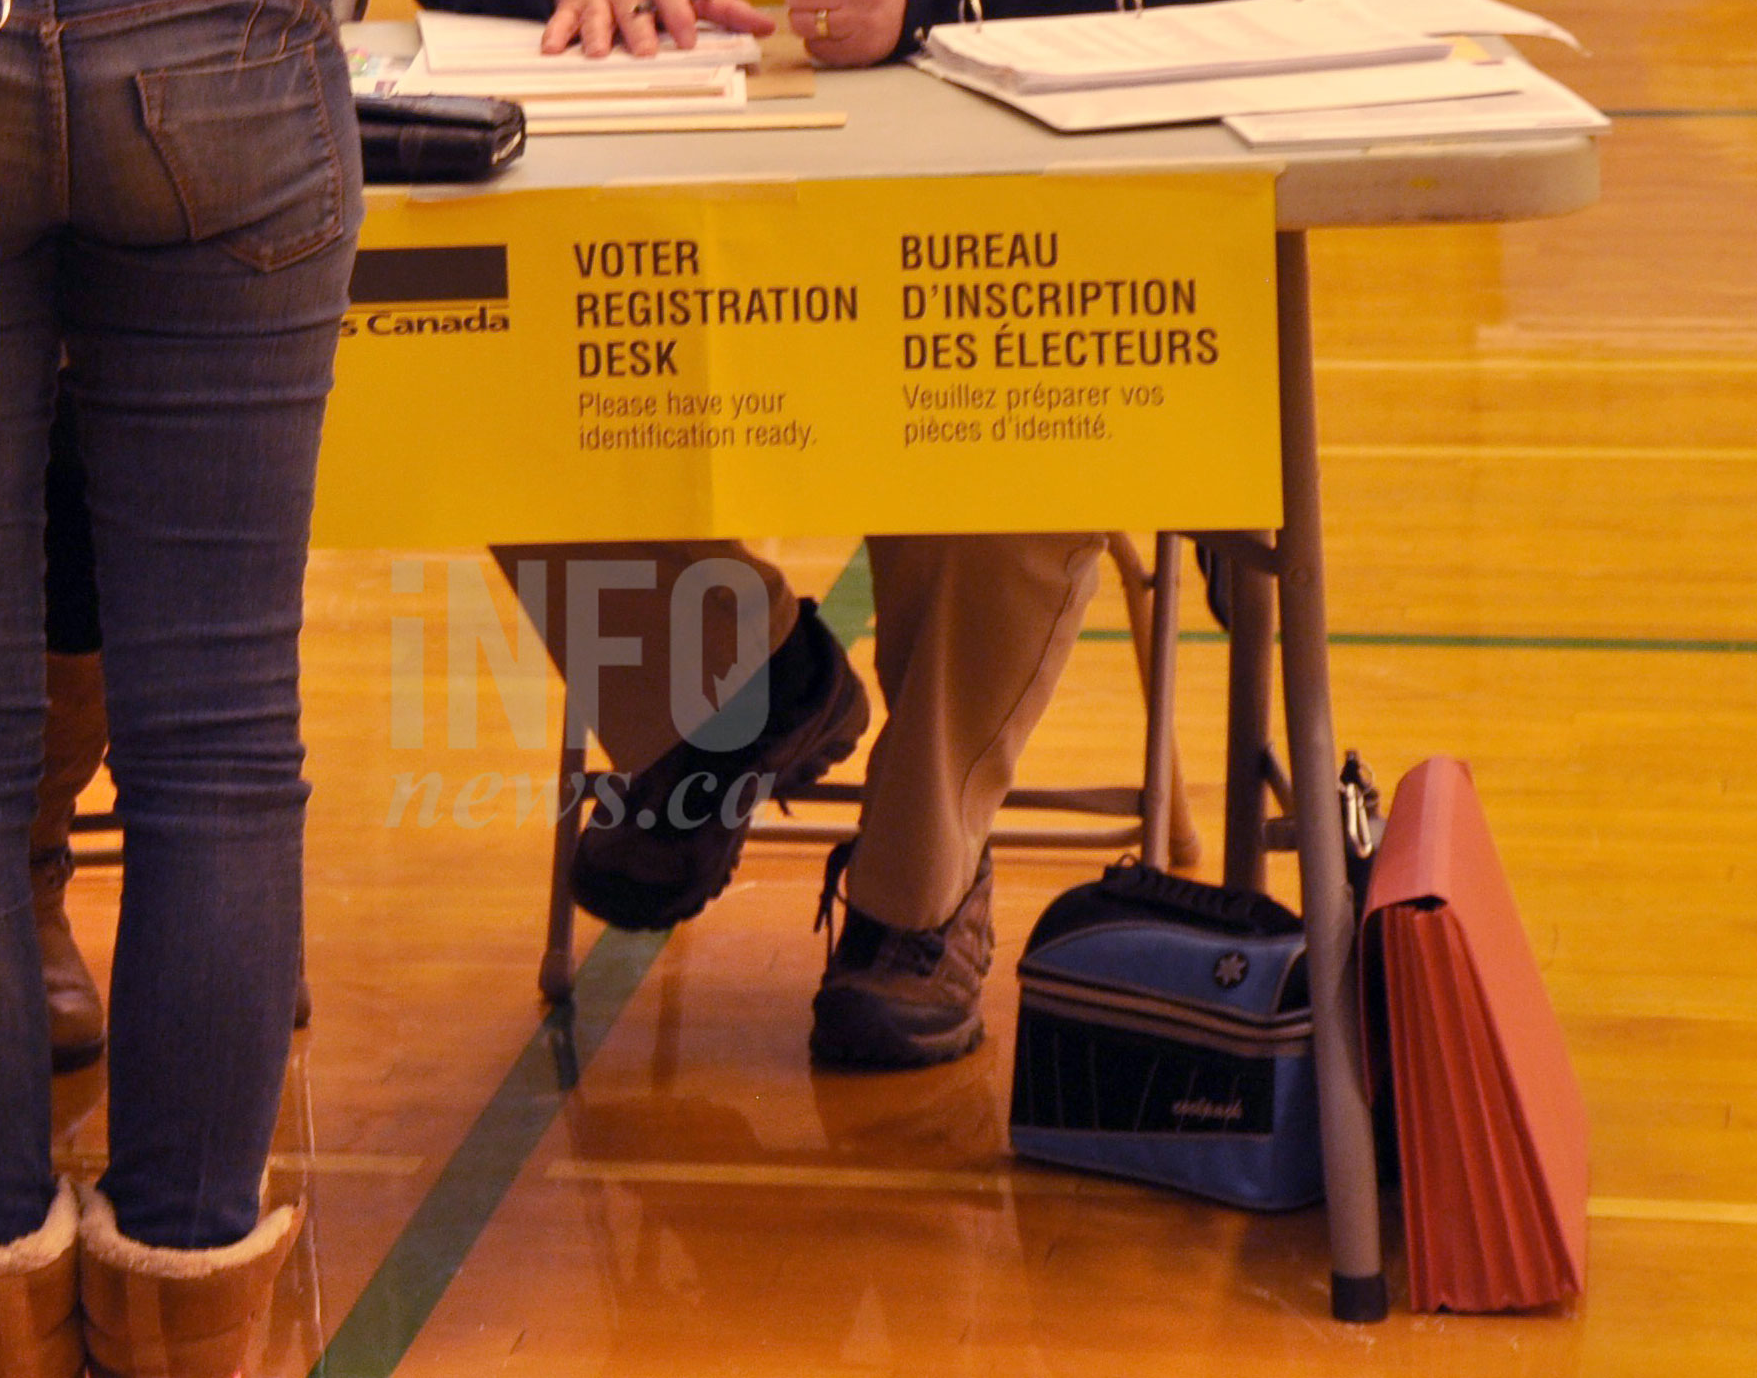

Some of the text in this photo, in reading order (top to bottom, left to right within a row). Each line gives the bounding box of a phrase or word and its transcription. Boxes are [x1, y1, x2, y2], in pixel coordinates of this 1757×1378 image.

[573, 241, 700, 278] VOTER
[901, 232, 1058, 271] BUREAU
[576, 286, 858, 328] REGISTRATION
[902, 279, 1196, 320] D'INSCRIPTION
[366, 306, 510, 336] Canada
[578, 341, 678, 378] DESK
[903, 322, 1219, 370] DES ÉLECTEURS
[579, 390, 786, 421] Please have your
[901, 382, 1165, 413] Veuillez préparer vos
[579, 419, 817, 452] identification ready.
[903, 416, 983, 448] pièces
